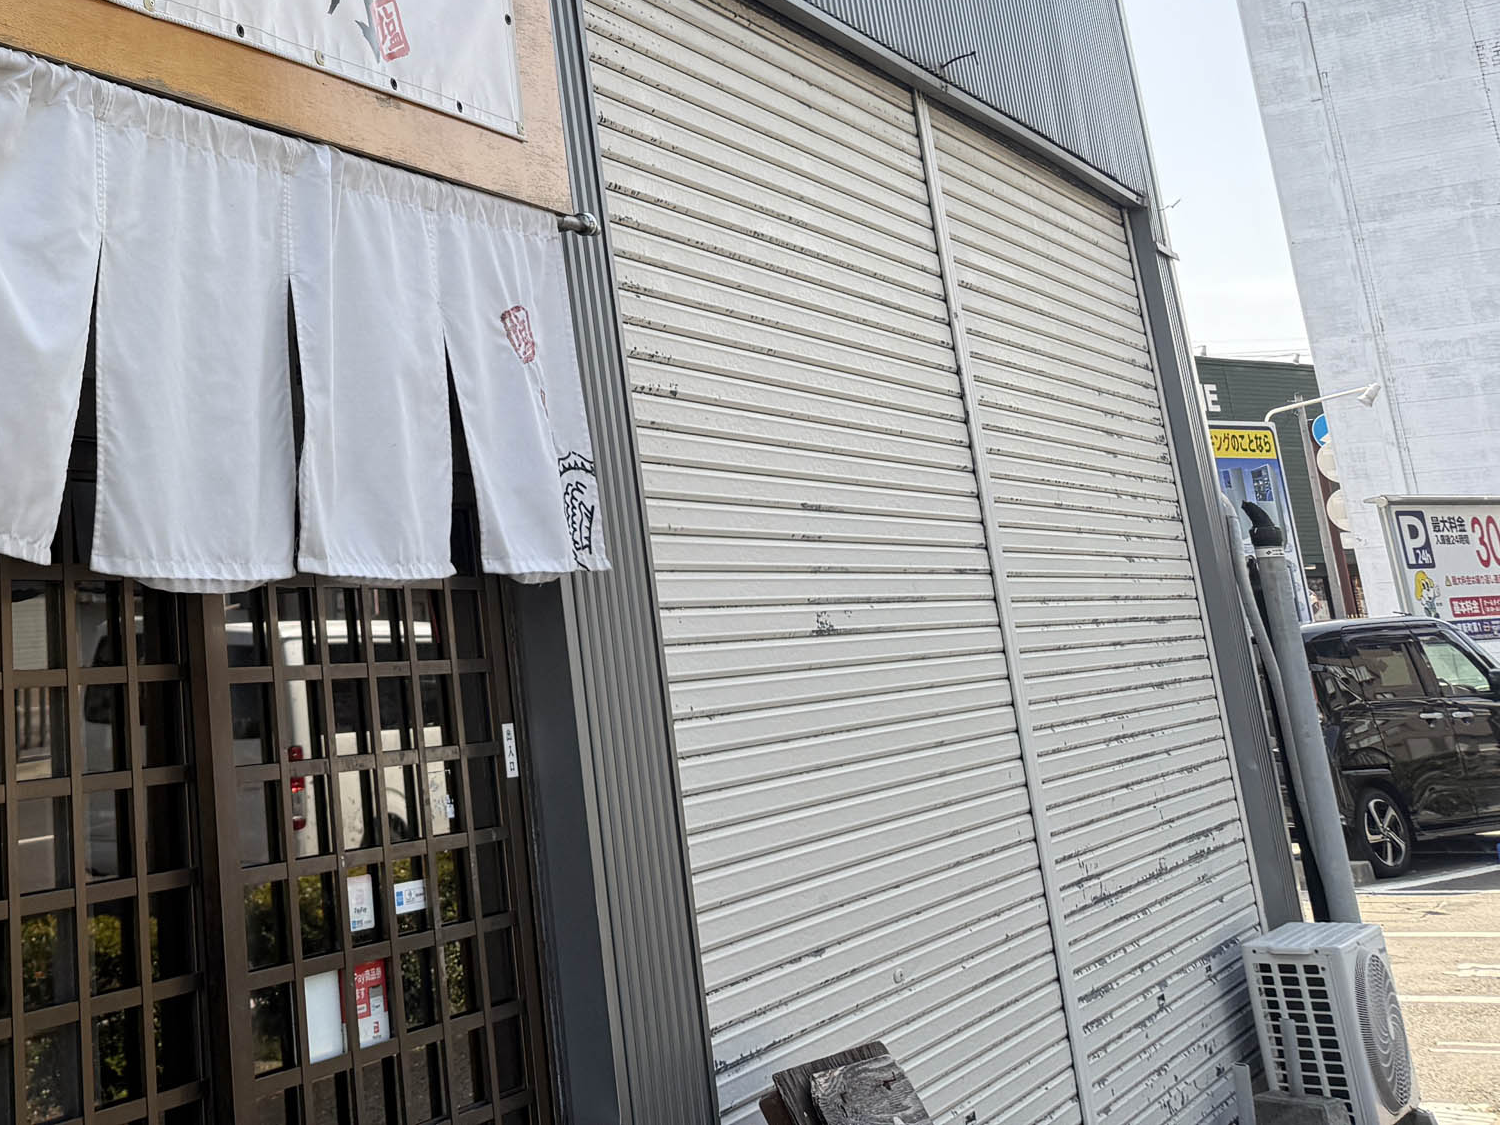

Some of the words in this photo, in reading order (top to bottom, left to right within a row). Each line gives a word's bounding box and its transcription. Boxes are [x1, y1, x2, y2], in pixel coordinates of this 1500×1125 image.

[1430, 515, 1468, 533] 最大料金
[1399, 515, 1426, 565] P
[1415, 549, 1432, 564] 24h
